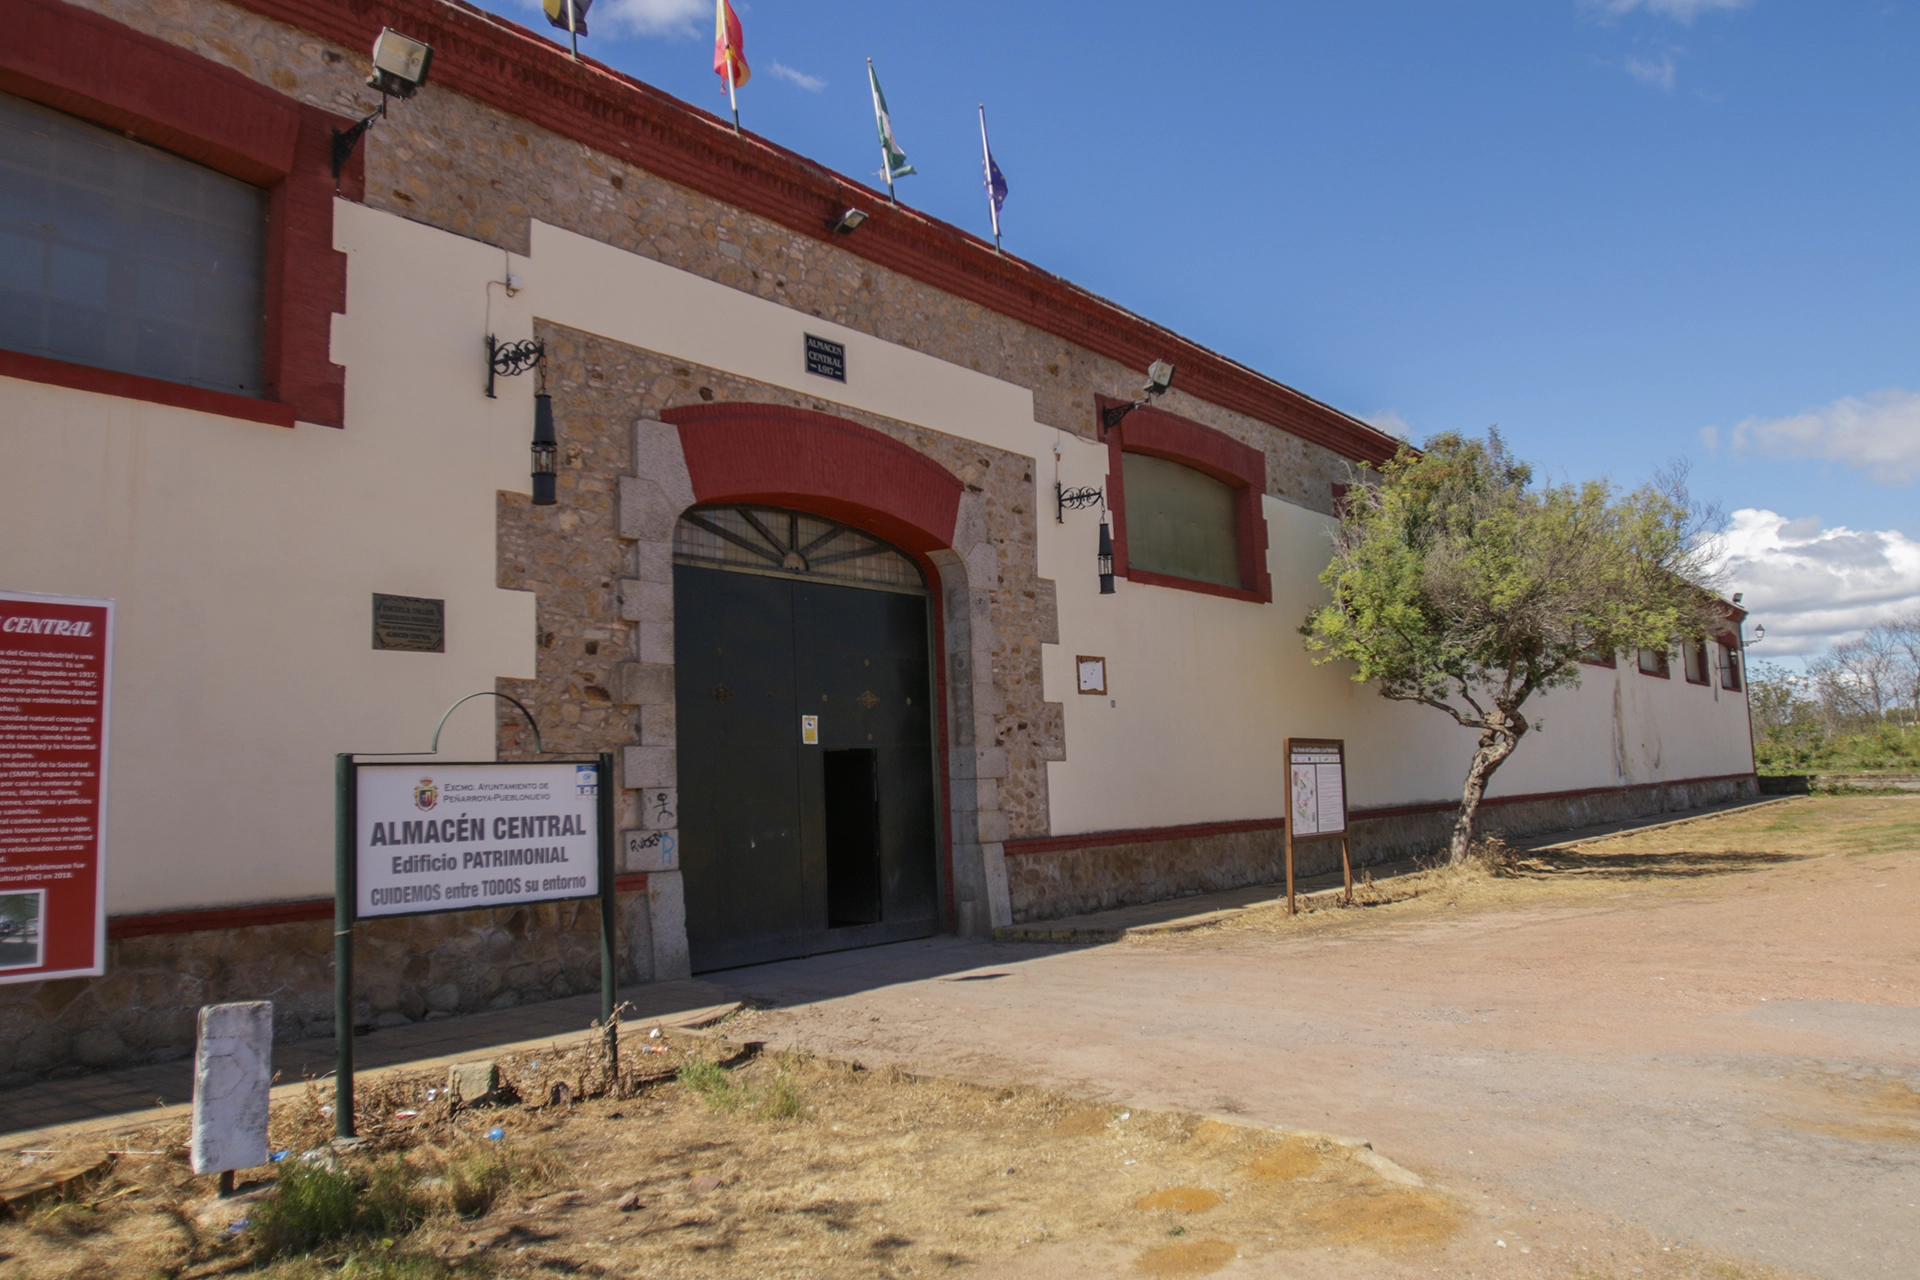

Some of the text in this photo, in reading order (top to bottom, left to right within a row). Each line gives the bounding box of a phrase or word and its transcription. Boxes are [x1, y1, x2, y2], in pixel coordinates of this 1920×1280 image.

[808, 338, 842, 356] ALMACEN
[808, 351, 842, 368] CENTRAL
[3, 617, 92, 637] CENTRAL
[370, 813, 586, 846] ALMACÉN CENTRAL
[392, 846, 568, 874] Edificio PATRIMONIAL
[371, 875, 586, 906] CUIDEMOS entre TODOS su entorno
